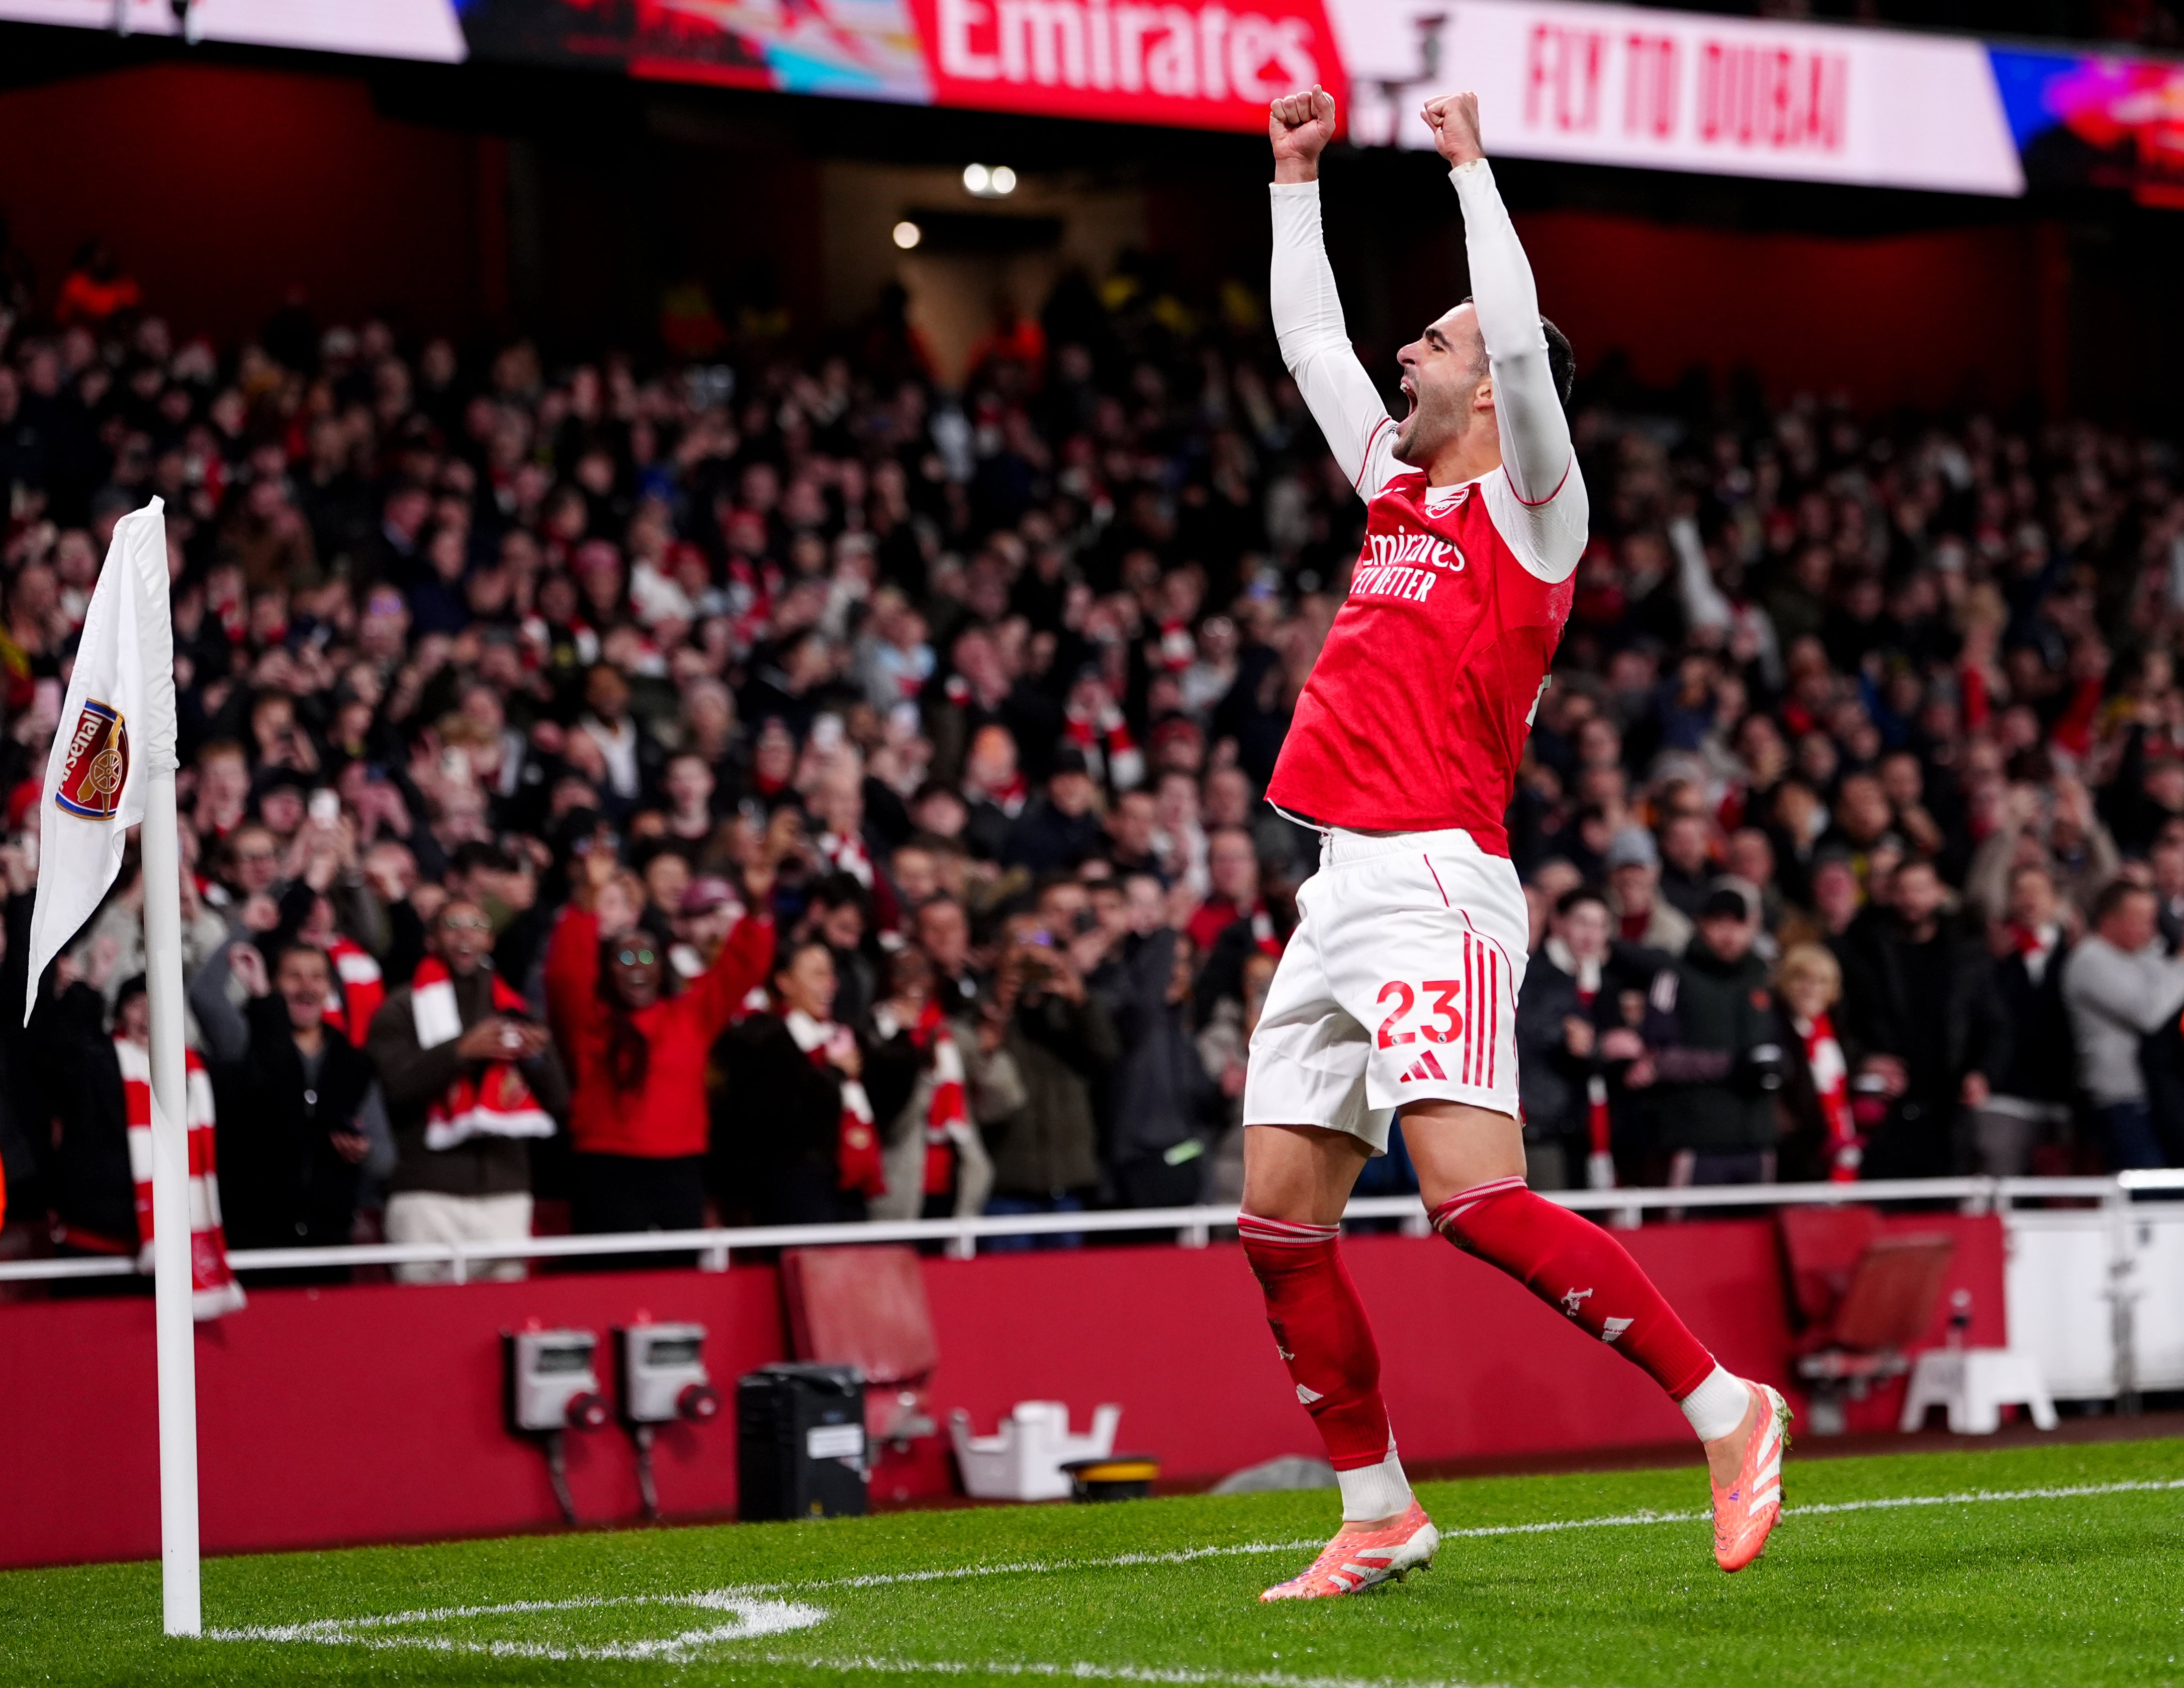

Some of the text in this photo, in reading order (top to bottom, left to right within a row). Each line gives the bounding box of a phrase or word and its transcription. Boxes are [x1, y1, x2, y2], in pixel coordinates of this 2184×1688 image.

[935, 0, 1318, 104] Emirates
[1524, 22, 1850, 155] FLY TO DUBAI
[1349, 567, 1436, 602] FLY BETTER
[1376, 980, 1464, 1051] 23
